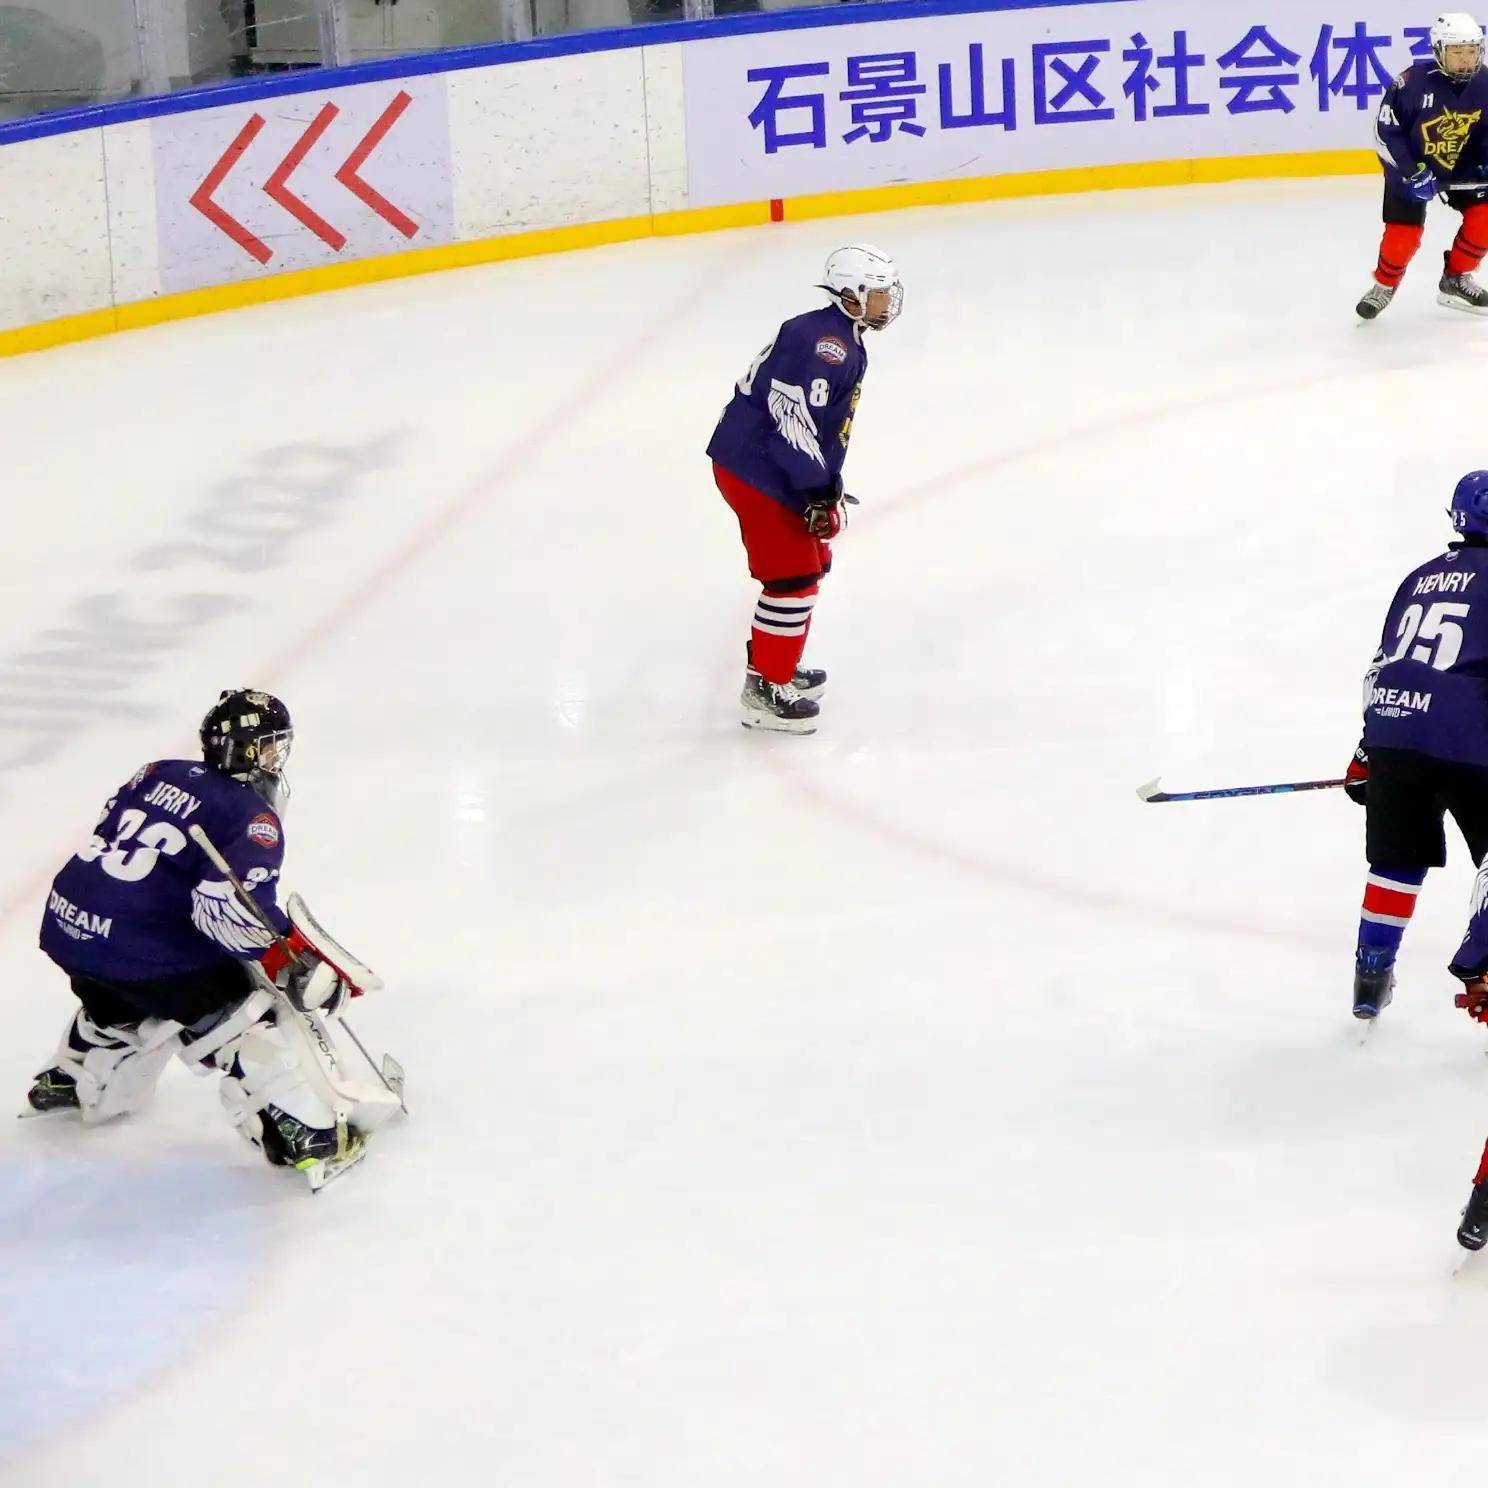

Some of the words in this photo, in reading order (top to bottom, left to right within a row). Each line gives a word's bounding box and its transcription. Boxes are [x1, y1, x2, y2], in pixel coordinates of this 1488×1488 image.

[817, 341, 847, 361] DREAM
[809, 377, 829, 407] 8
[1412, 572, 1476, 596] HENRY
[143, 780, 202, 820] JERRY
[49, 888, 114, 940] DREAM
